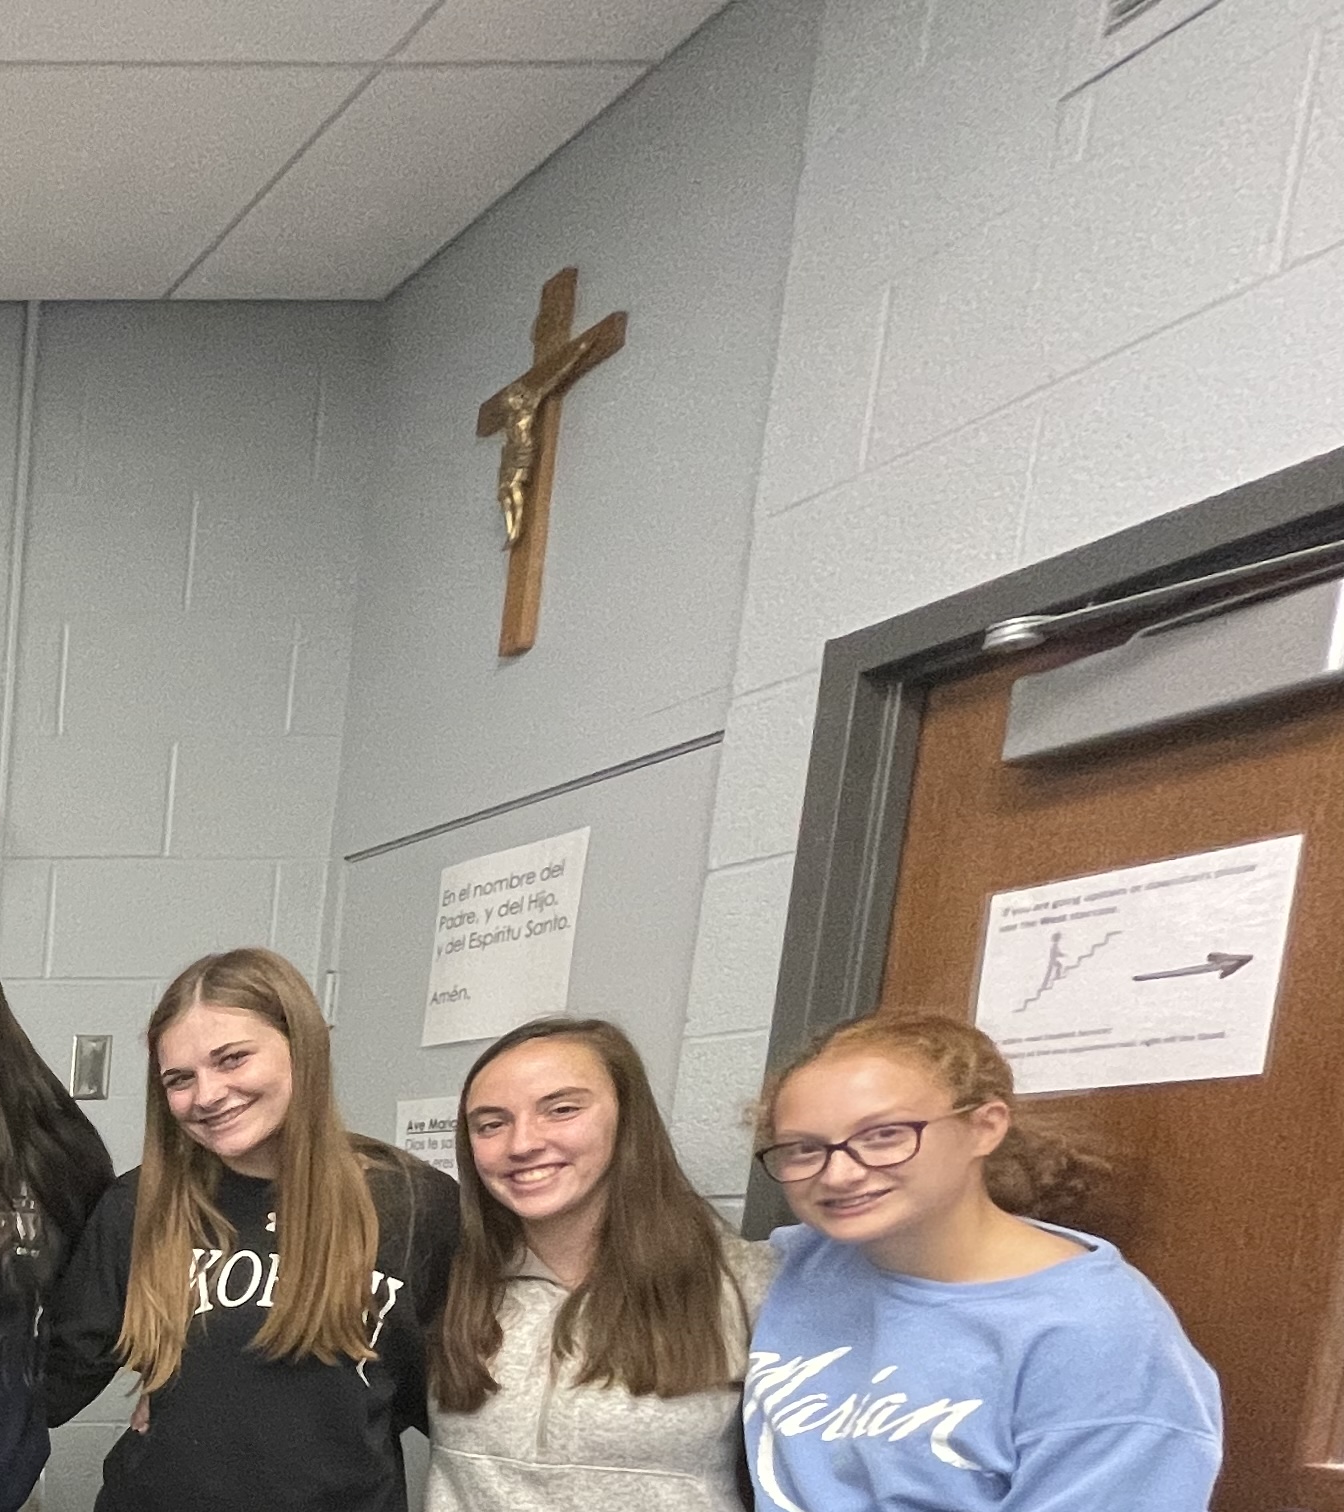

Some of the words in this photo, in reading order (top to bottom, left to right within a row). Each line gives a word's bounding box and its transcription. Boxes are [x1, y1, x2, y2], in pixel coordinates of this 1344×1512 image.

[441, 889, 457, 908] En
[458, 883, 471, 902] el
[472, 871, 536, 898] nombre
[539, 858, 566, 882] del
[484, 905, 495, 925] y
[497, 894, 525, 918] del
[444, 935, 466, 955] del
[524, 914, 572, 940] Santo.
